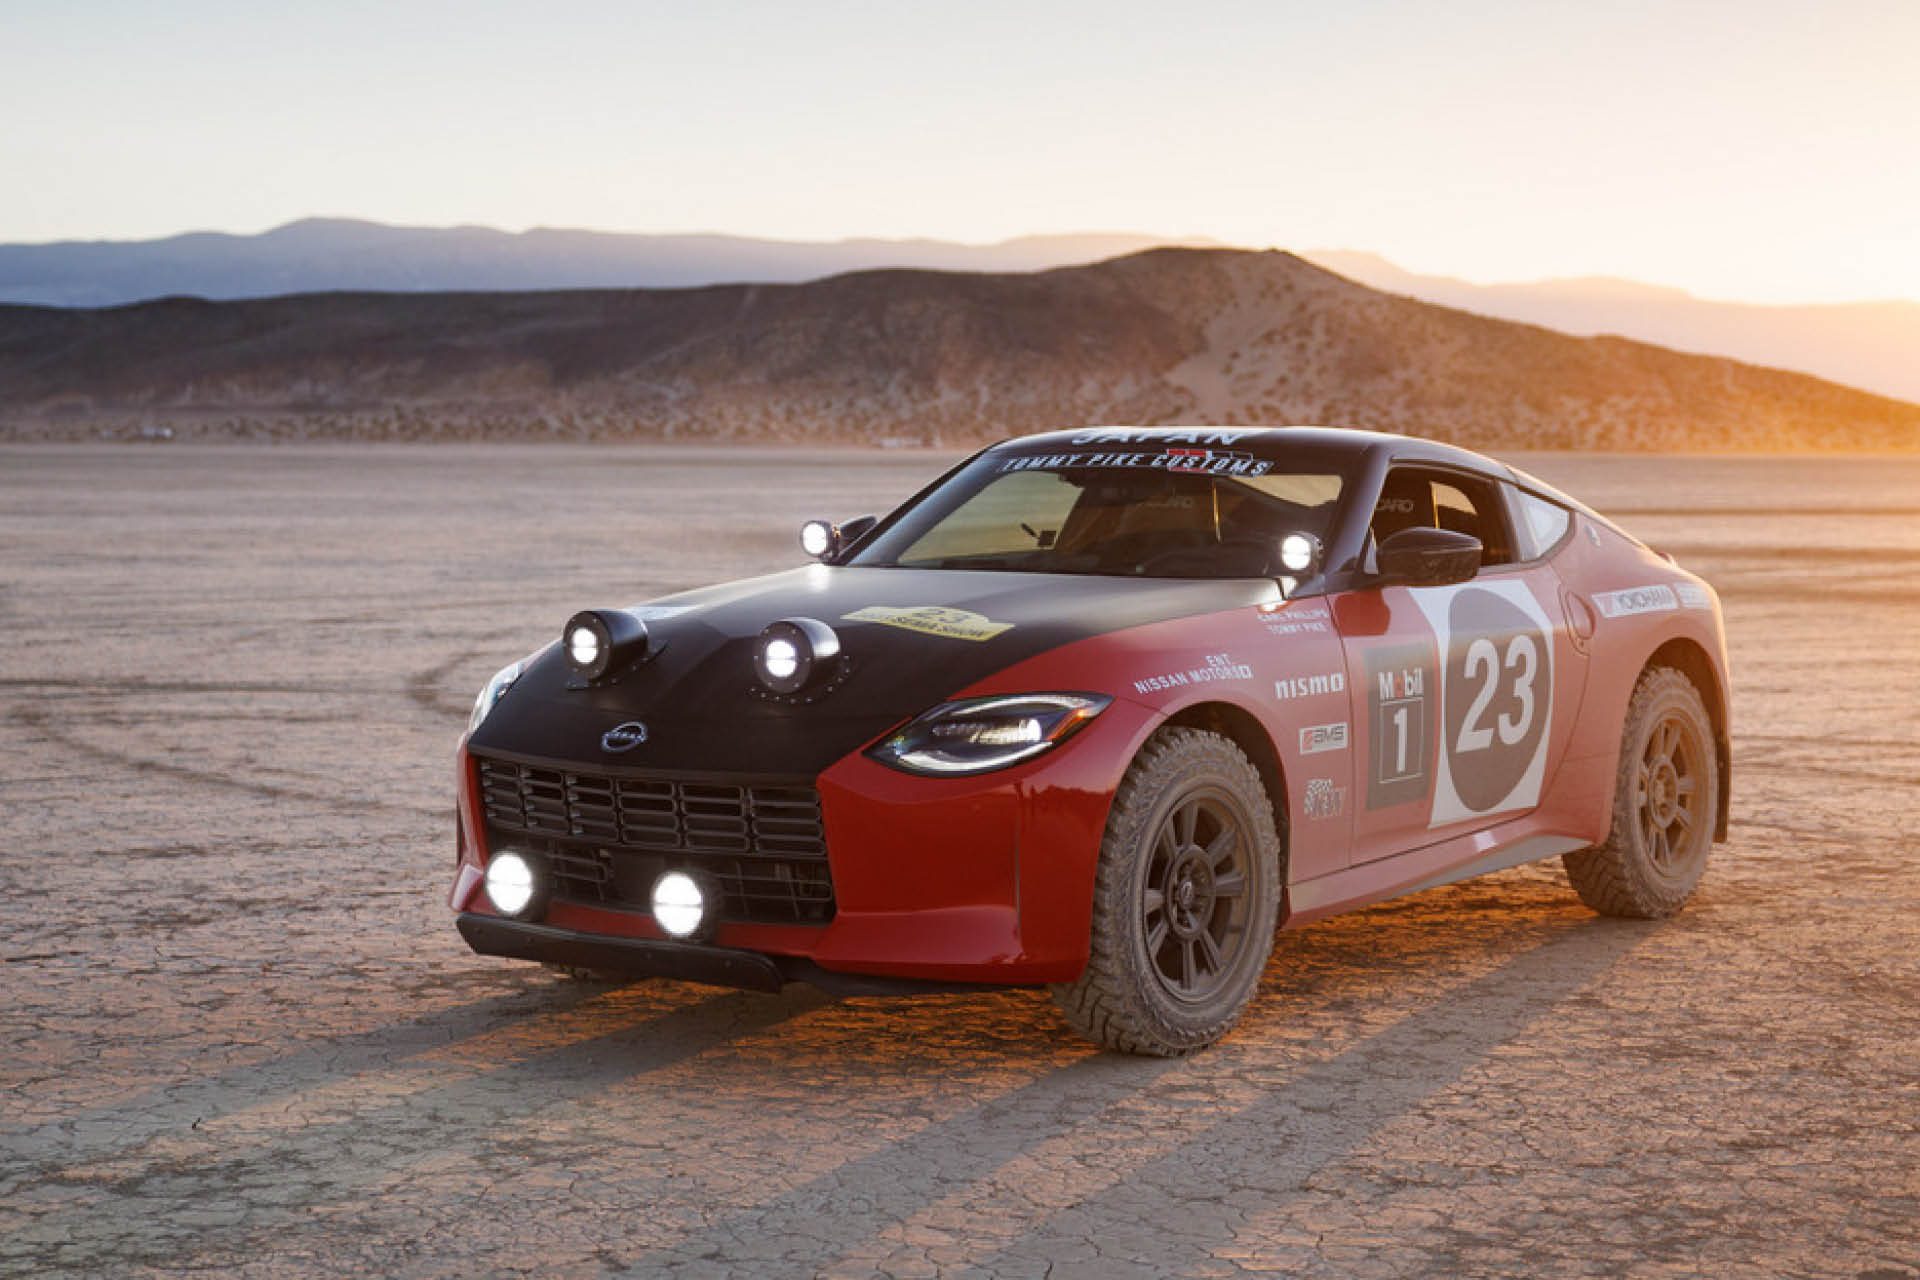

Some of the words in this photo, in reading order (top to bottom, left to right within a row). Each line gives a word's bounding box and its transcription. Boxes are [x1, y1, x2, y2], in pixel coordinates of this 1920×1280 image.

[1001, 454, 1082, 472] TOMMY
[1087, 453, 1145, 467] PIKE
[1150, 454, 1270, 478] CUSTOMS
[1133, 671, 1189, 694] NISSAN
[1275, 671, 1344, 699] nismo
[1378, 667, 1425, 699] Mobil
[1455, 634, 1538, 753] 23
[1394, 707, 1408, 773] 1
